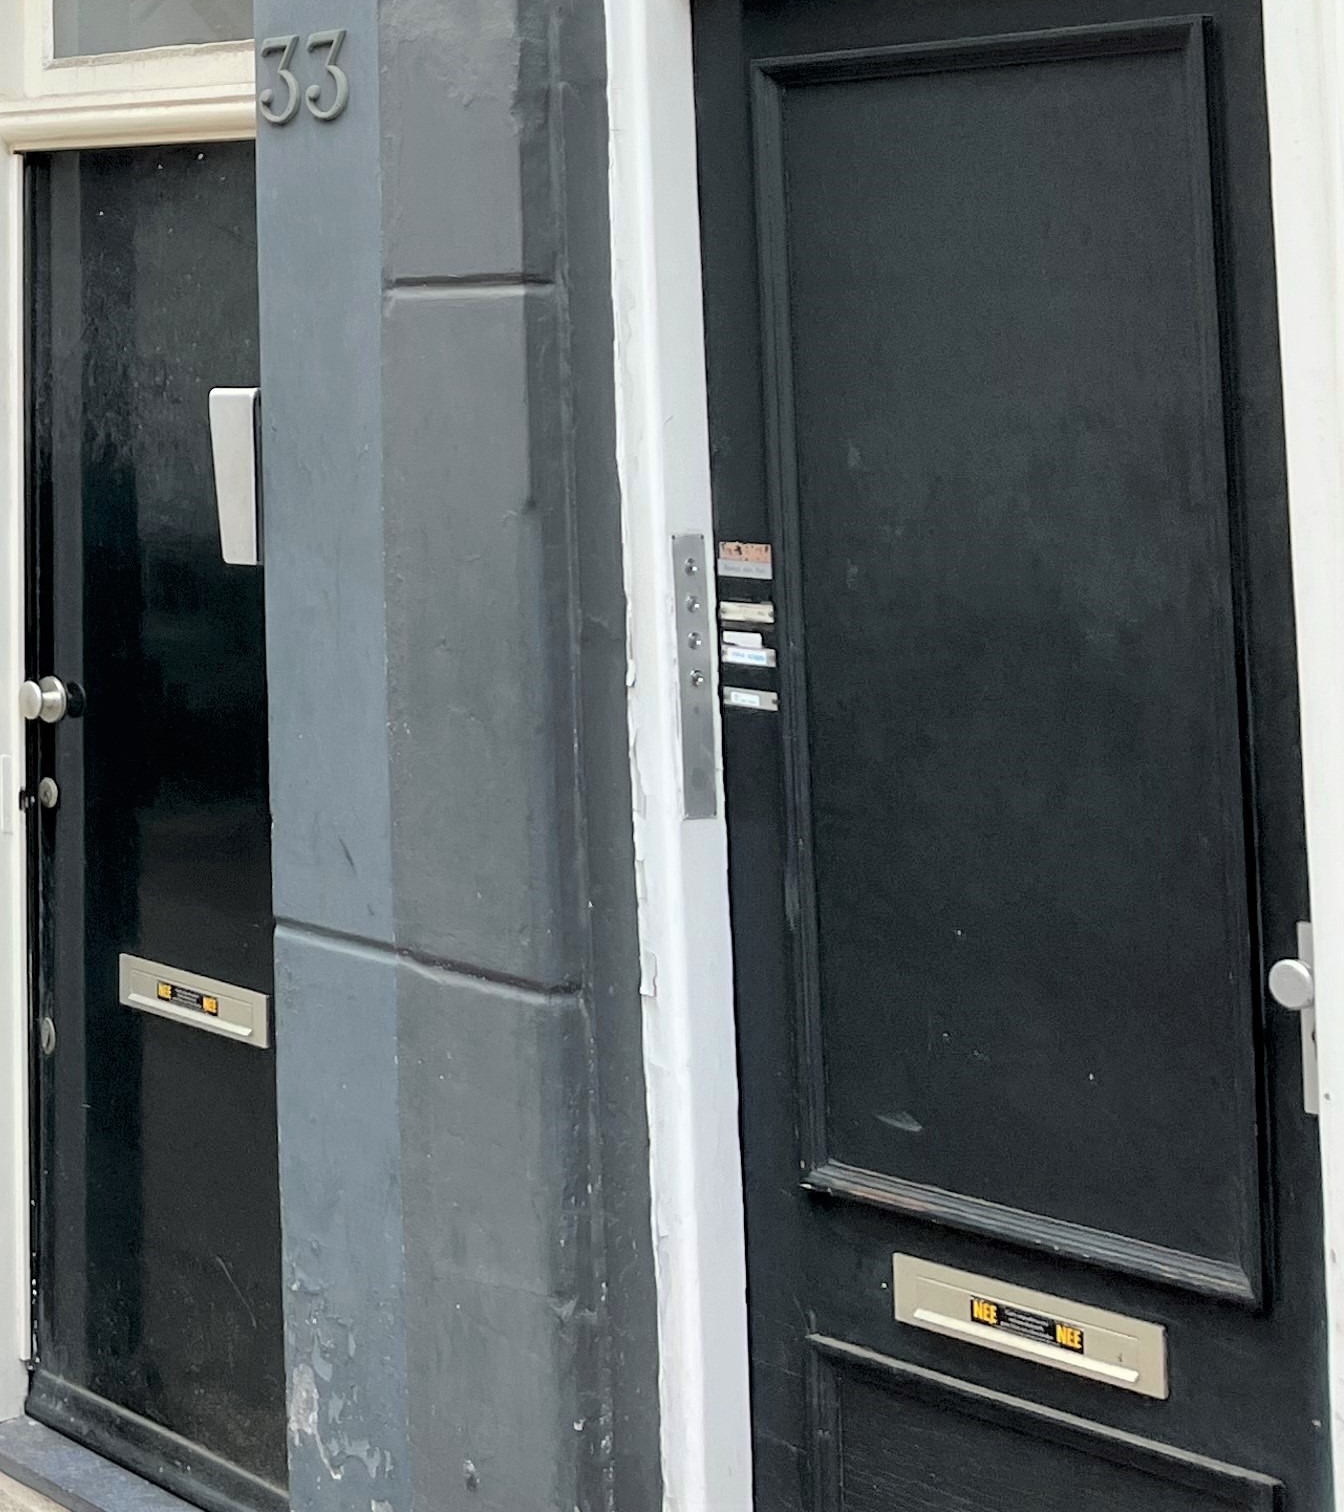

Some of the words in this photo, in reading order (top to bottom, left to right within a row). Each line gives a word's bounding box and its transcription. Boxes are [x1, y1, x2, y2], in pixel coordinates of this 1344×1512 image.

[259, 28, 350, 124] 33
[973, 1298, 998, 1325] NEE
[1055, 1323, 1082, 1349] NEE
